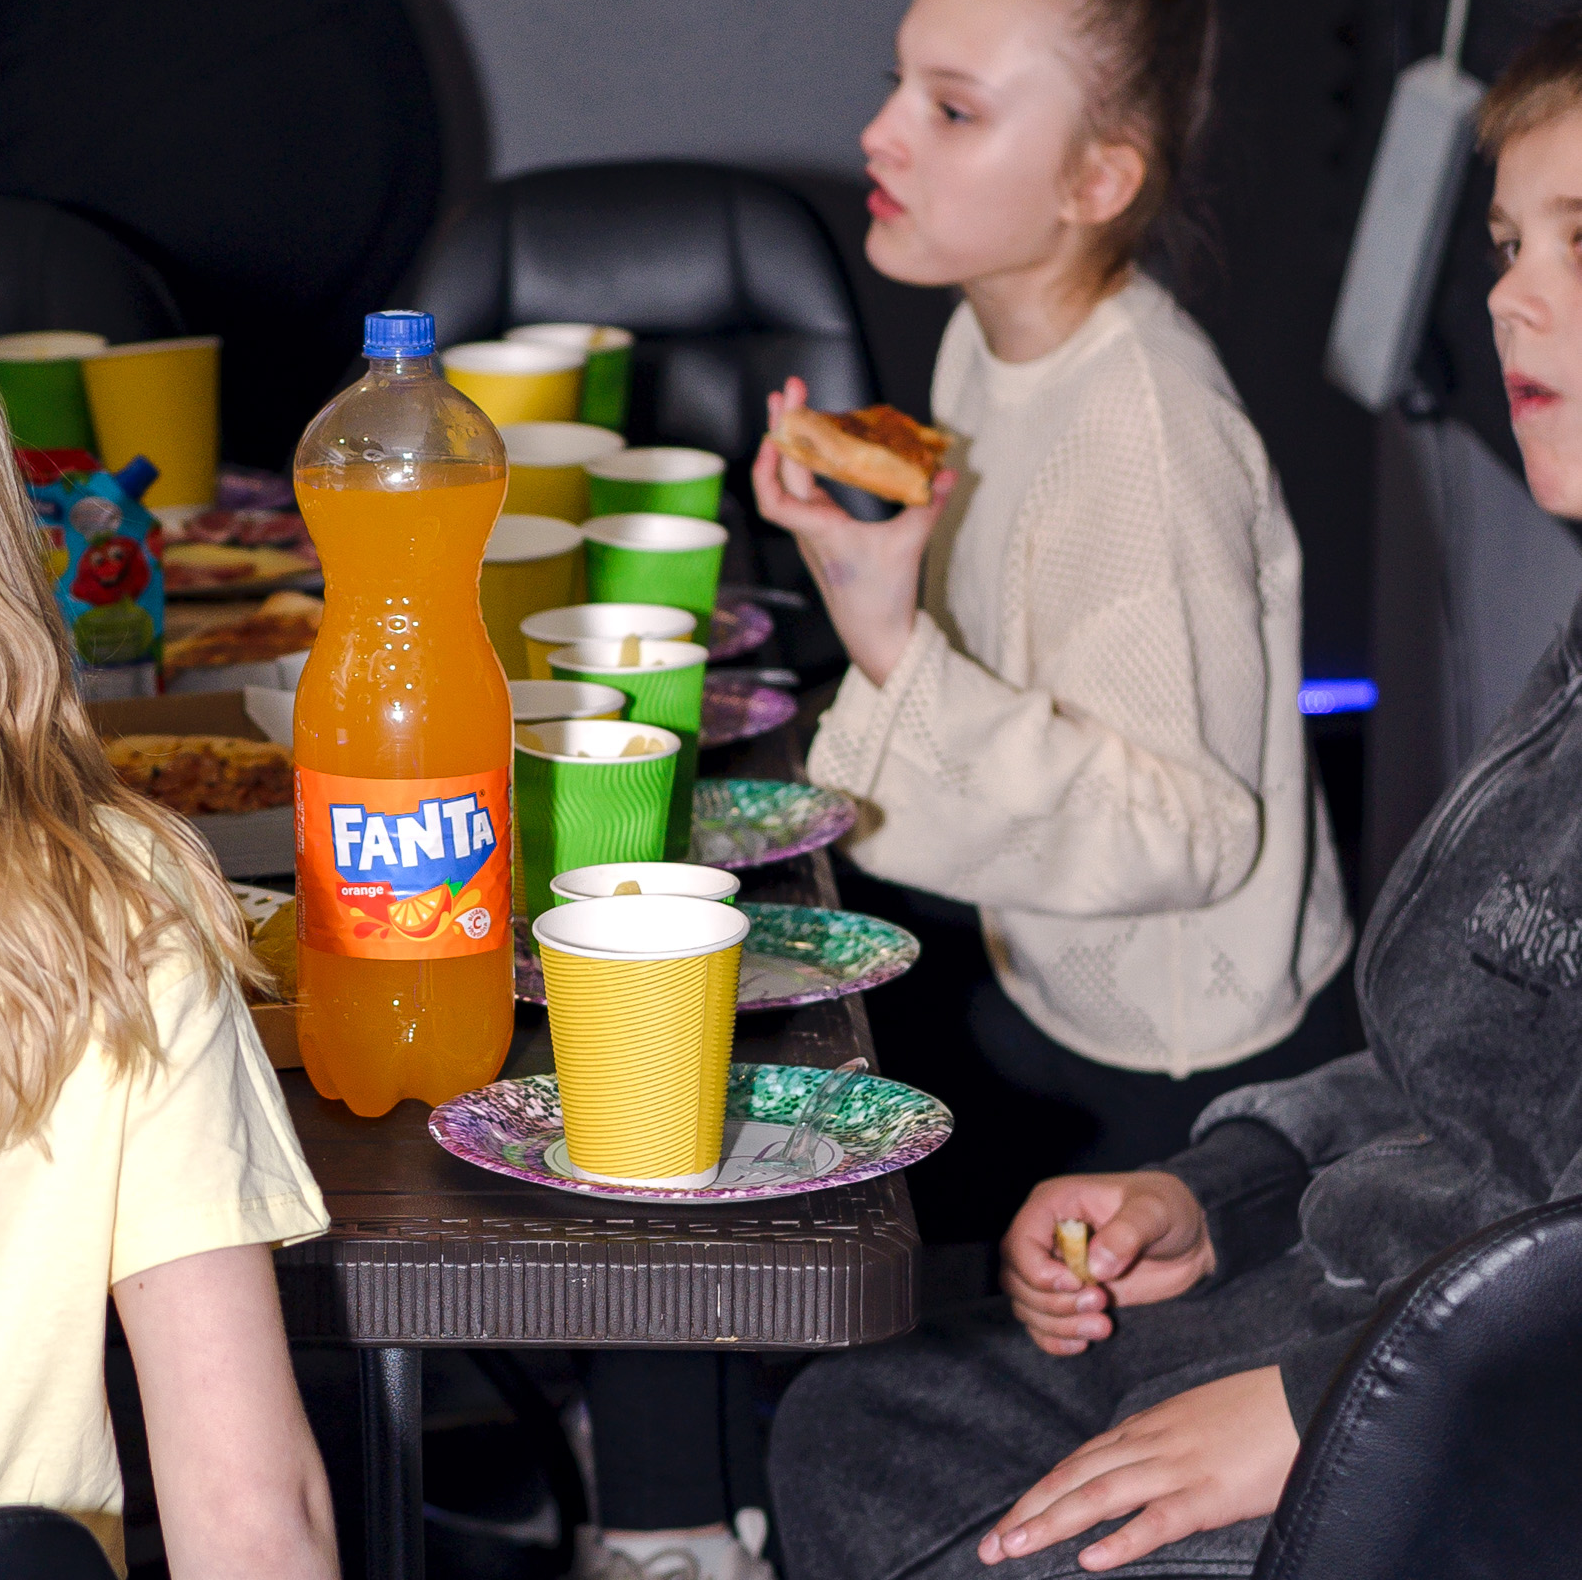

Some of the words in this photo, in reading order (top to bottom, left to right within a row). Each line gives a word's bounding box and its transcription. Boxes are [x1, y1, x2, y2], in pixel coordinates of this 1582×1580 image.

[331, 796, 494, 871] FANTA
[341, 885, 385, 898] orange
[473, 916, 482, 930] C
